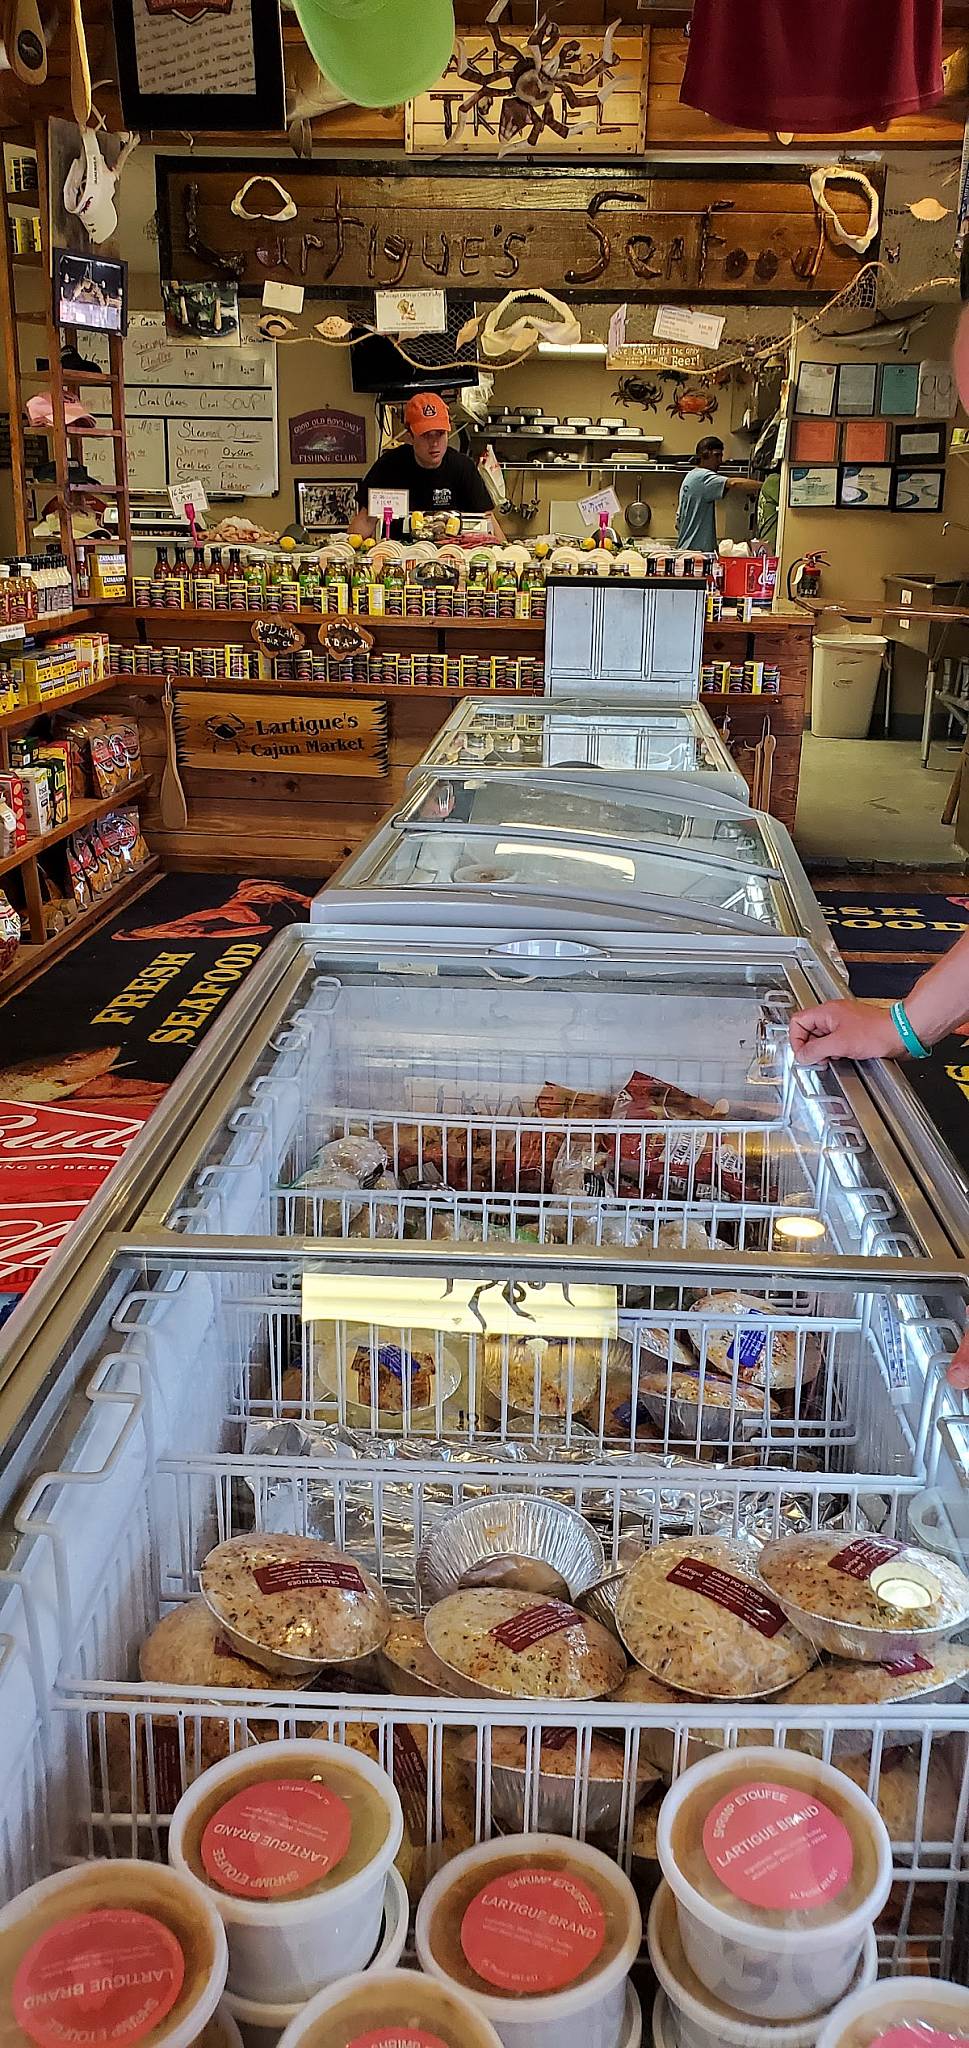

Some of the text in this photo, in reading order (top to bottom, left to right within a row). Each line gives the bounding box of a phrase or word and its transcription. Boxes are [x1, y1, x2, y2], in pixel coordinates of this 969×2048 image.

[312, 417, 325, 426] OLD
[299, 454, 357, 463] FISHING CLUB
[256, 712, 359, 736] Lartigue's
[251, 736, 365, 760] Cajun Market
[90, 951, 197, 1025] FRESH
[147, 943, 263, 1044] SEAFOOD
[730, 1579, 764, 1603] POTATOES
[213, 1823, 263, 1844] BRAND
[716, 1825, 779, 1868] LARTIGUE
[776, 1804, 820, 1832] BRAND
[260, 1834, 330, 1866] LARTIGUE
[250, 1869, 300, 1889] SHRIMP
[481, 1894, 597, 1940] LARTIGUE BRAND
[23, 1968, 174, 2010] LARTIGUE BRAND
